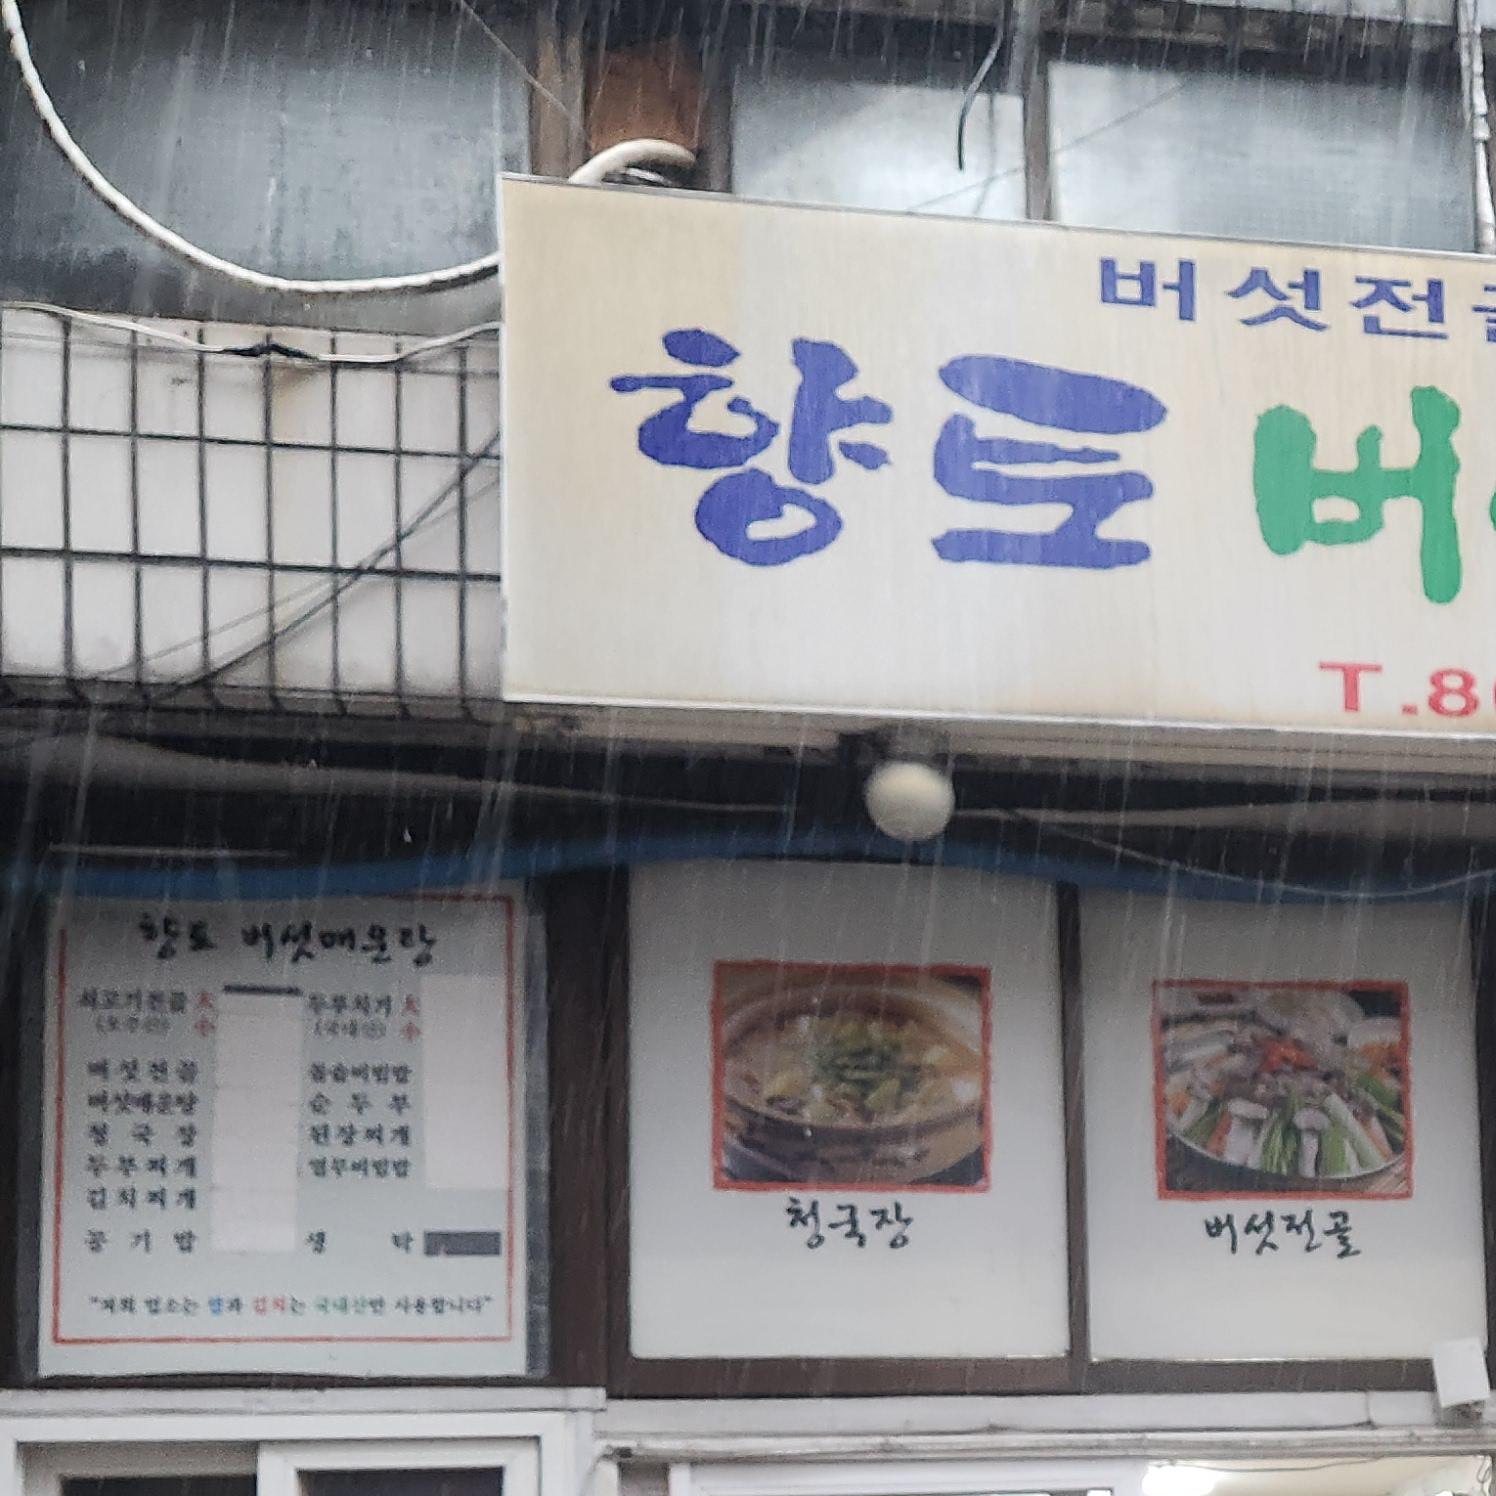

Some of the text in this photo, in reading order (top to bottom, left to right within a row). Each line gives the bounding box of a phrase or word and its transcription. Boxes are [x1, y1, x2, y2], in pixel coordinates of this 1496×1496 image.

[610, 327, 1166, 568] 향토
[138, 912, 438, 968] 향토 버섯매운탕
[87, 1057, 199, 1084] 버섯전골
[87, 1090, 199, 1116] 버섯매운탕
[86, 1185, 198, 1212] 김치찌개
[786, 1194, 915, 1250] 청국장
[1203, 1209, 1363, 1259] 버섯전골
